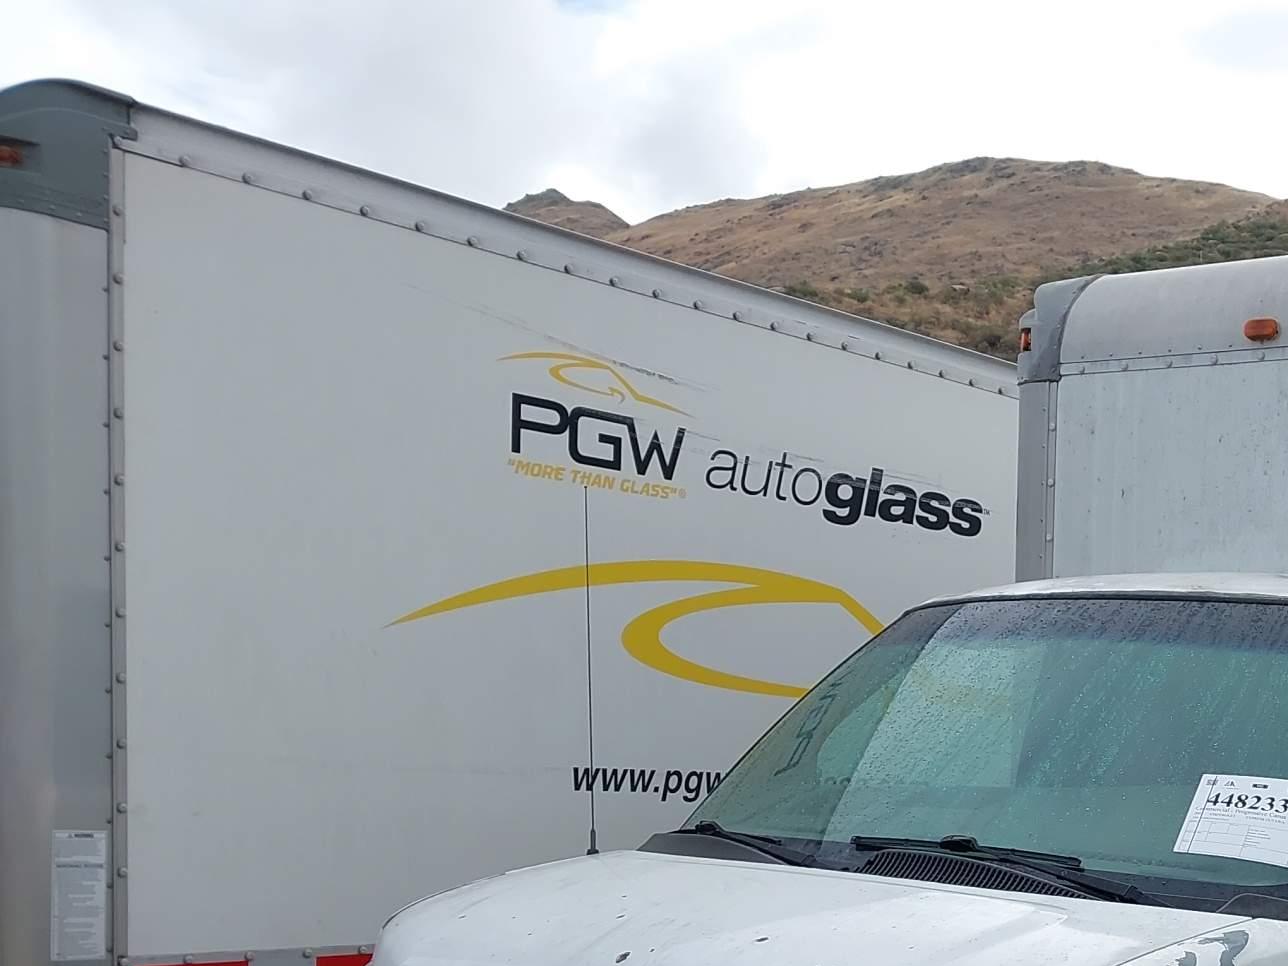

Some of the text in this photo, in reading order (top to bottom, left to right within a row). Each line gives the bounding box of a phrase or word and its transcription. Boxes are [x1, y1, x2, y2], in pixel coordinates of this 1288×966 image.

[511, 392, 687, 481] PGW
[508, 458, 566, 481] "MORE
[570, 470, 616, 490] THAN
